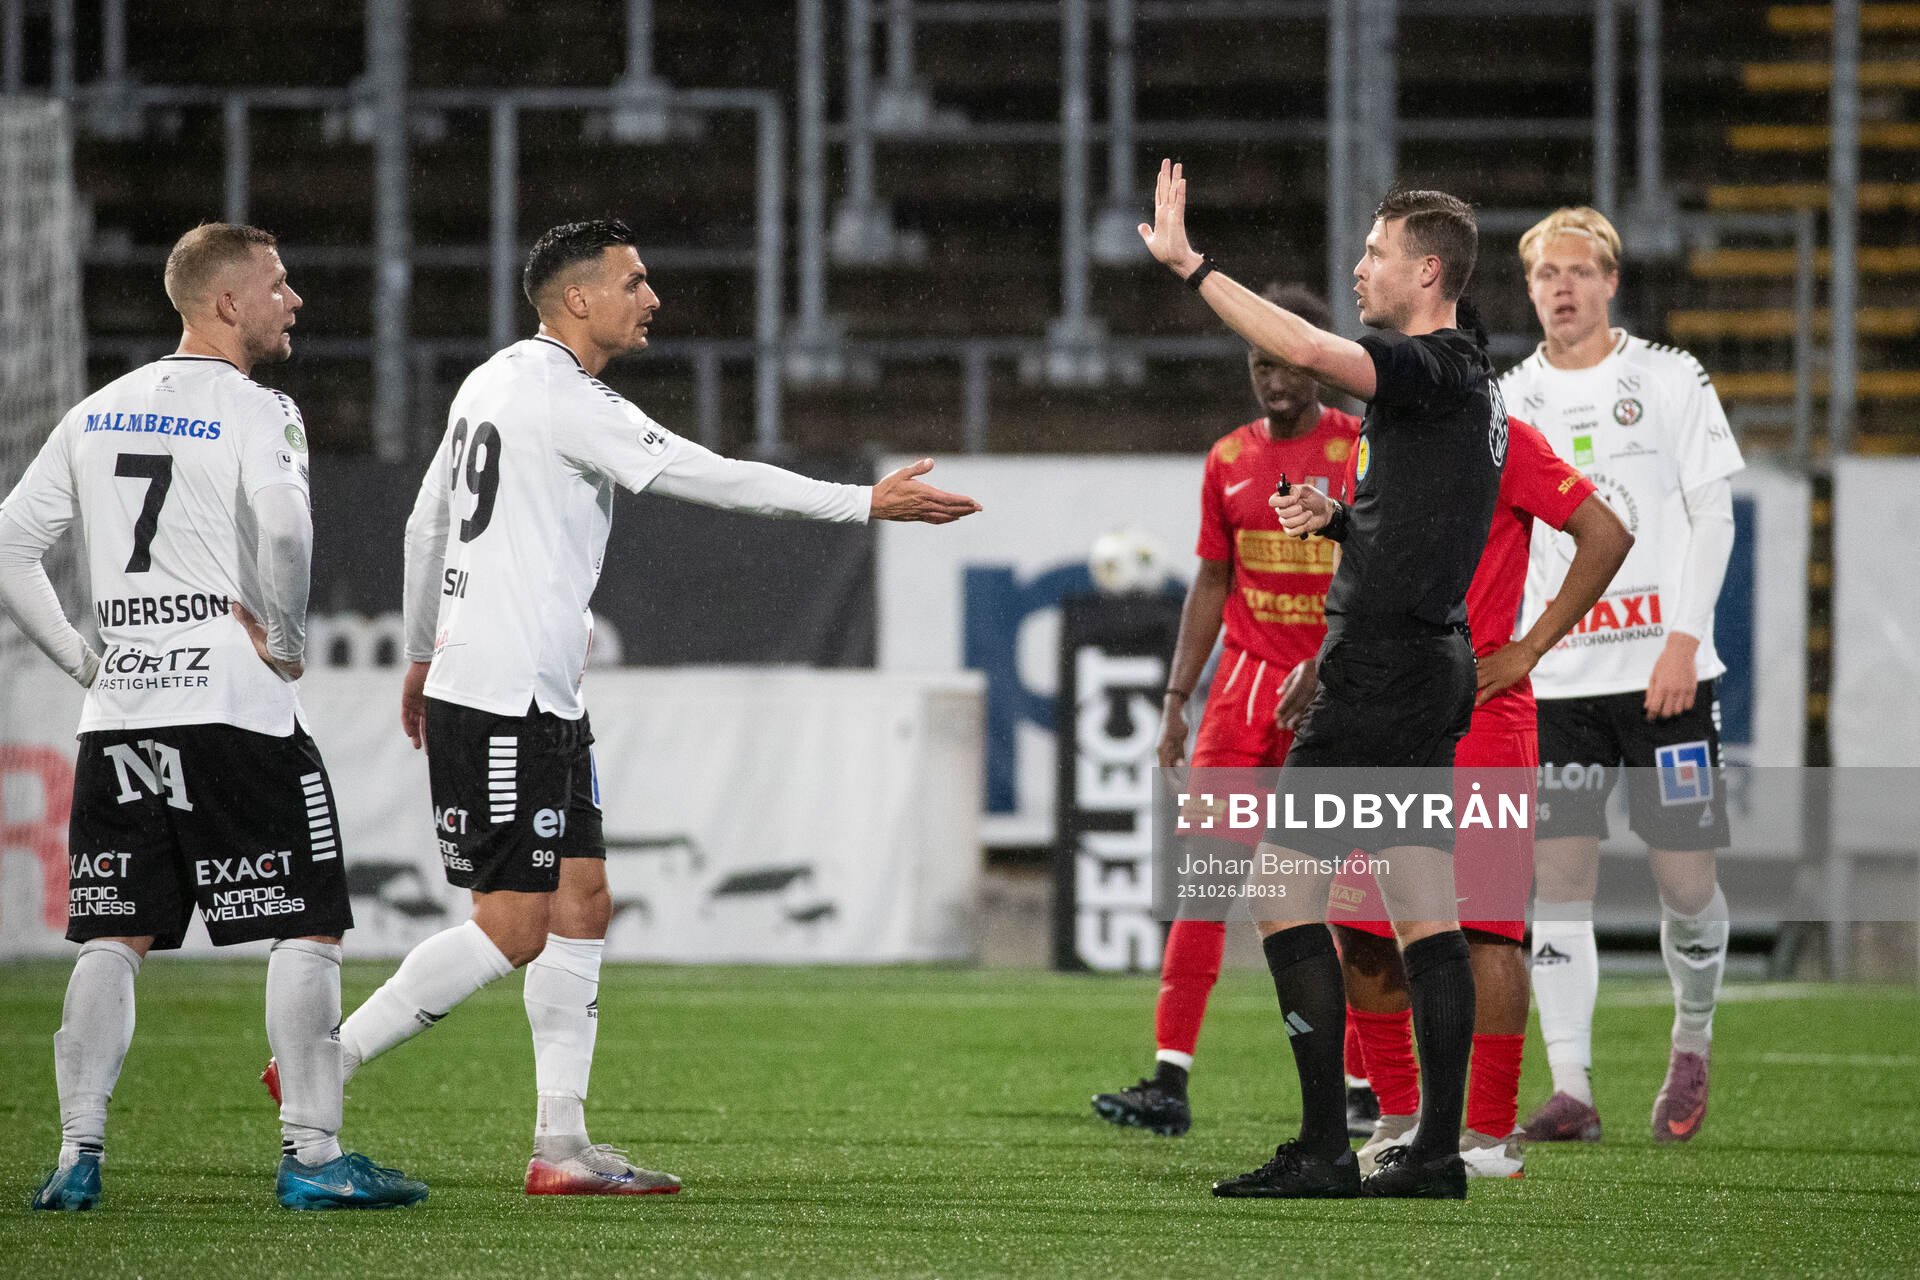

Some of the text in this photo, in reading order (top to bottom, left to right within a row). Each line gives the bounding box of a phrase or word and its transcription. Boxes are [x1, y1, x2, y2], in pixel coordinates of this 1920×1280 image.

[84, 412, 222, 440] MALMBERGS
[114, 453, 174, 574] 7
[96, 593, 229, 628] NDERSSON
[104, 647, 211, 674] GÖRTZ
[98, 675, 209, 690] FASTIGHETER
[434, 805, 469, 834] ACT
[1075, 645, 1165, 971] SELECT
[69, 850, 132, 879] XACT
[195, 849, 293, 886] EXACT
[532, 850, 555, 867] 99
[70, 886, 119, 902] ORDIC
[213, 885, 286, 906] NORDIC
[69, 901, 136, 917] ELLNESS
[200, 897, 306, 923] WELLNESS
